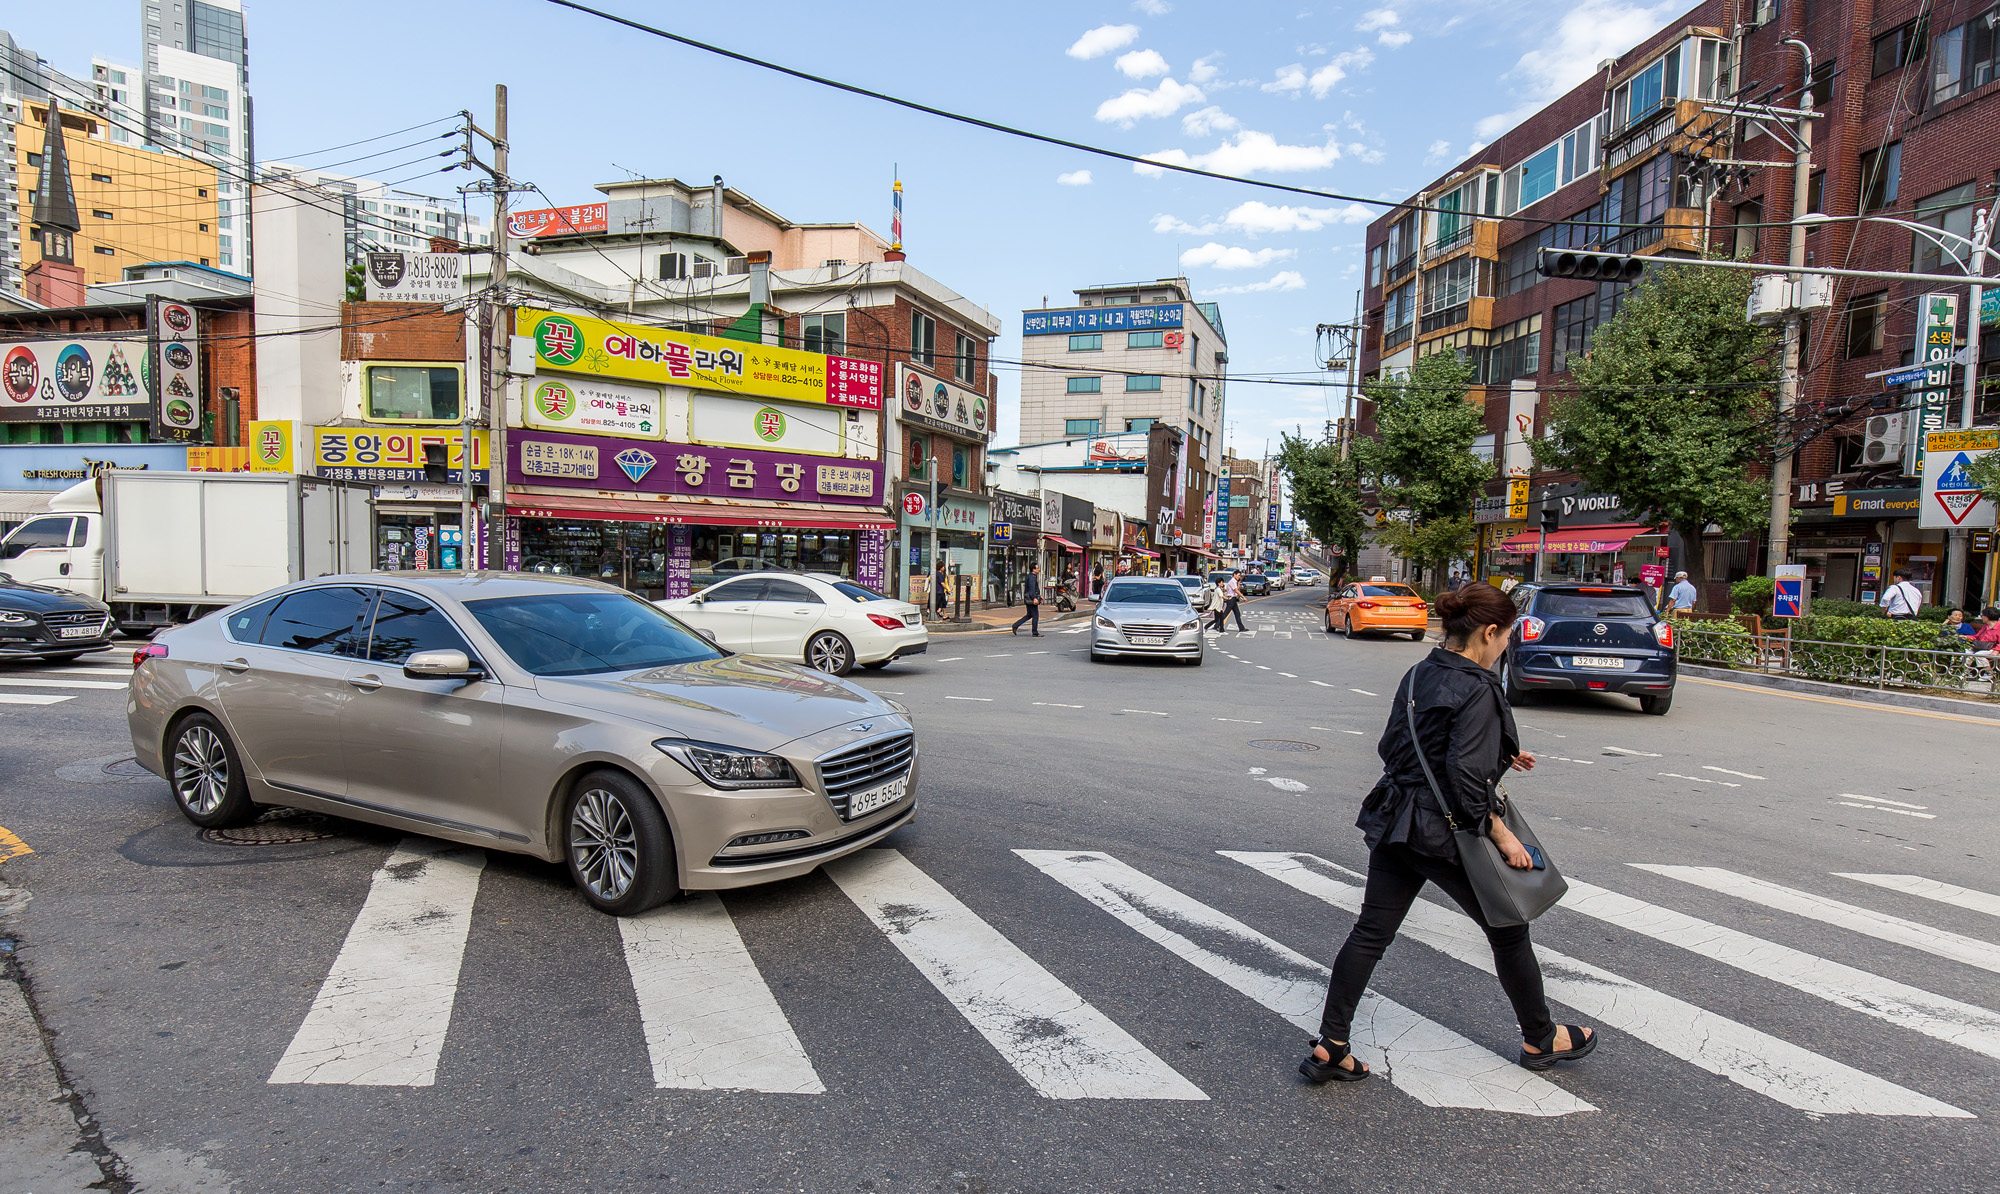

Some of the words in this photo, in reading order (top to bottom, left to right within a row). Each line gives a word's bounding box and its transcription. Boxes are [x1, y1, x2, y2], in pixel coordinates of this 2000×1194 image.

[375, 261, 400, 280] 본죽
[409, 280, 430, 288] 중앙대
[421, 293, 452, 301] 드립니다
[1025, 317, 1046, 330] 산부인과
[1052, 315, 1072, 328] 피부과
[1078, 313, 1097, 327] 치과
[1105, 312, 1124, 325] 내과
[543, 322, 575, 360] 꽃
[1164, 333, 1184, 353] 약
[1928, 331, 1952, 344] 소망
[605, 336, 743, 378] 예하플라워
[800, 364, 823, 375] 서비스
[838, 360, 878, 374] 경조화환
[719, 375, 743, 386] Flower
[838, 371, 878, 384] 동서양란
[544, 387, 566, 416] 꽃
[838, 393, 878, 406] 꽃바구니
[37, 406, 60, 418] 최고급
[62, 406, 110, 418] 다빈치당구대
[113, 405, 129, 416] 설치
[590, 399, 651, 416] 예하플라워
[761, 412, 781, 438] 꽃
[173, 429, 190, 439] 2F
[263, 431, 280, 459] 꽃
[1971, 441, 1994, 449] ZONE
[39, 470, 57, 478] FRESH
[60, 470, 84, 478] COFFEE
[675, 454, 806, 493] 황금당
[1853, 498, 1885, 510] emart
[1160, 512, 1173, 524] M
[995, 526, 1010, 537] 사진
[1777, 594, 1798, 602] 주차금지
[1597, 658, 1620, 667] 0935
[857, 791, 878, 812] 69보
[882, 780, 903, 803] 5540
